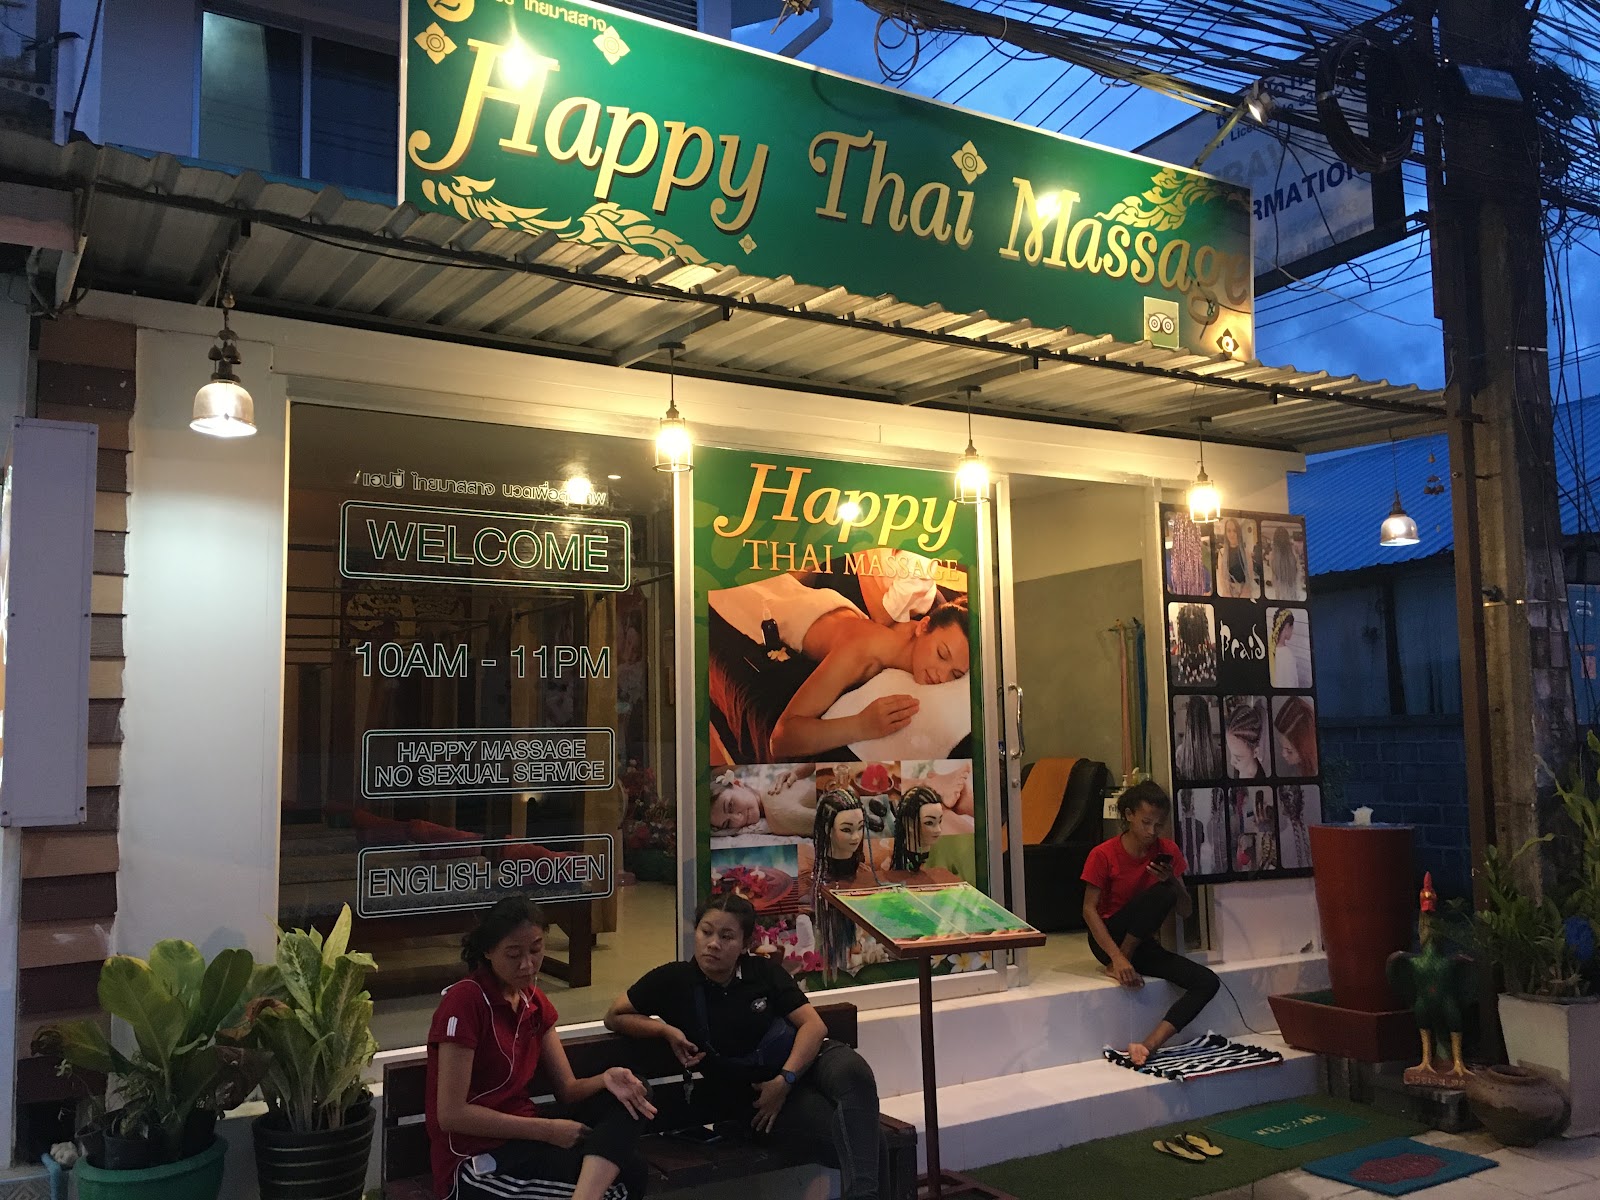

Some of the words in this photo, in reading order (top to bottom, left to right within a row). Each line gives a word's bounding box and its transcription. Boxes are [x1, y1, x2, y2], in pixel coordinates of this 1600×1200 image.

[408, 38, 770, 235] Happy
[808, 129, 975, 249] Thai
[999, 177, 1248, 326] Massage
[713, 462, 958, 553] Happy
[366, 519, 610, 573] WELCOME
[742, 538, 833, 575] THAI
[843, 552, 960, 582] MASSAGE
[355, 641, 469, 678] 10AM
[481, 658, 497, 669] -
[511, 644, 610, 679] 11PM
[397, 740, 477, 763] HAPPY
[481, 739, 587, 761] MASSAGE
[374, 765, 413, 787] NO
[417, 763, 509, 787] SEXUAL
[513, 760, 605, 782] SERVICE
[368, 862, 491, 898] ENGLISH
[498, 854, 605, 889] SPOKEN
